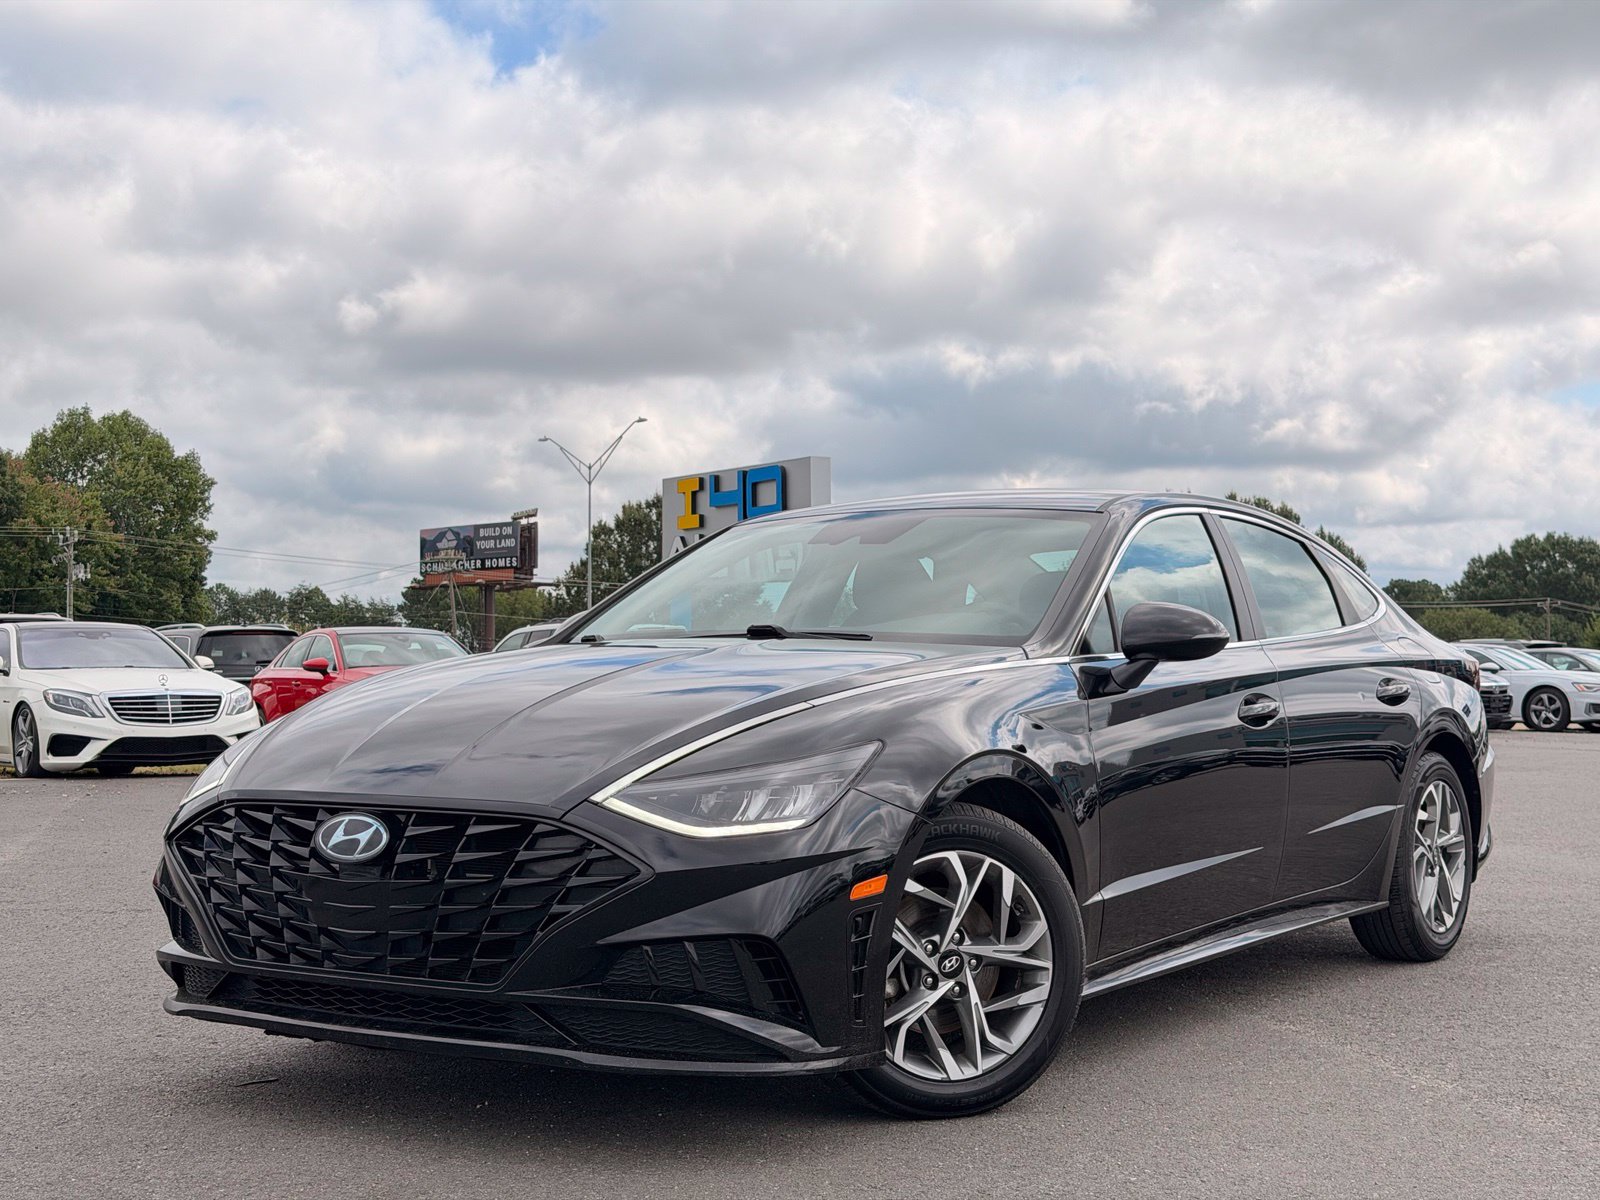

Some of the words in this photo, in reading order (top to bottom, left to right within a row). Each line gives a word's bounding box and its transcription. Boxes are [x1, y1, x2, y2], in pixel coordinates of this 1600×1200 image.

[677, 464, 787, 530] I40
[480, 527, 500, 537] BUILD
[502, 526, 513, 536] ON
[476, 540, 495, 549] YOUR
[497, 538, 516, 548] LAND
[421, 559, 482, 573] SCHUACHER
[485, 557, 518, 568] HOMES
